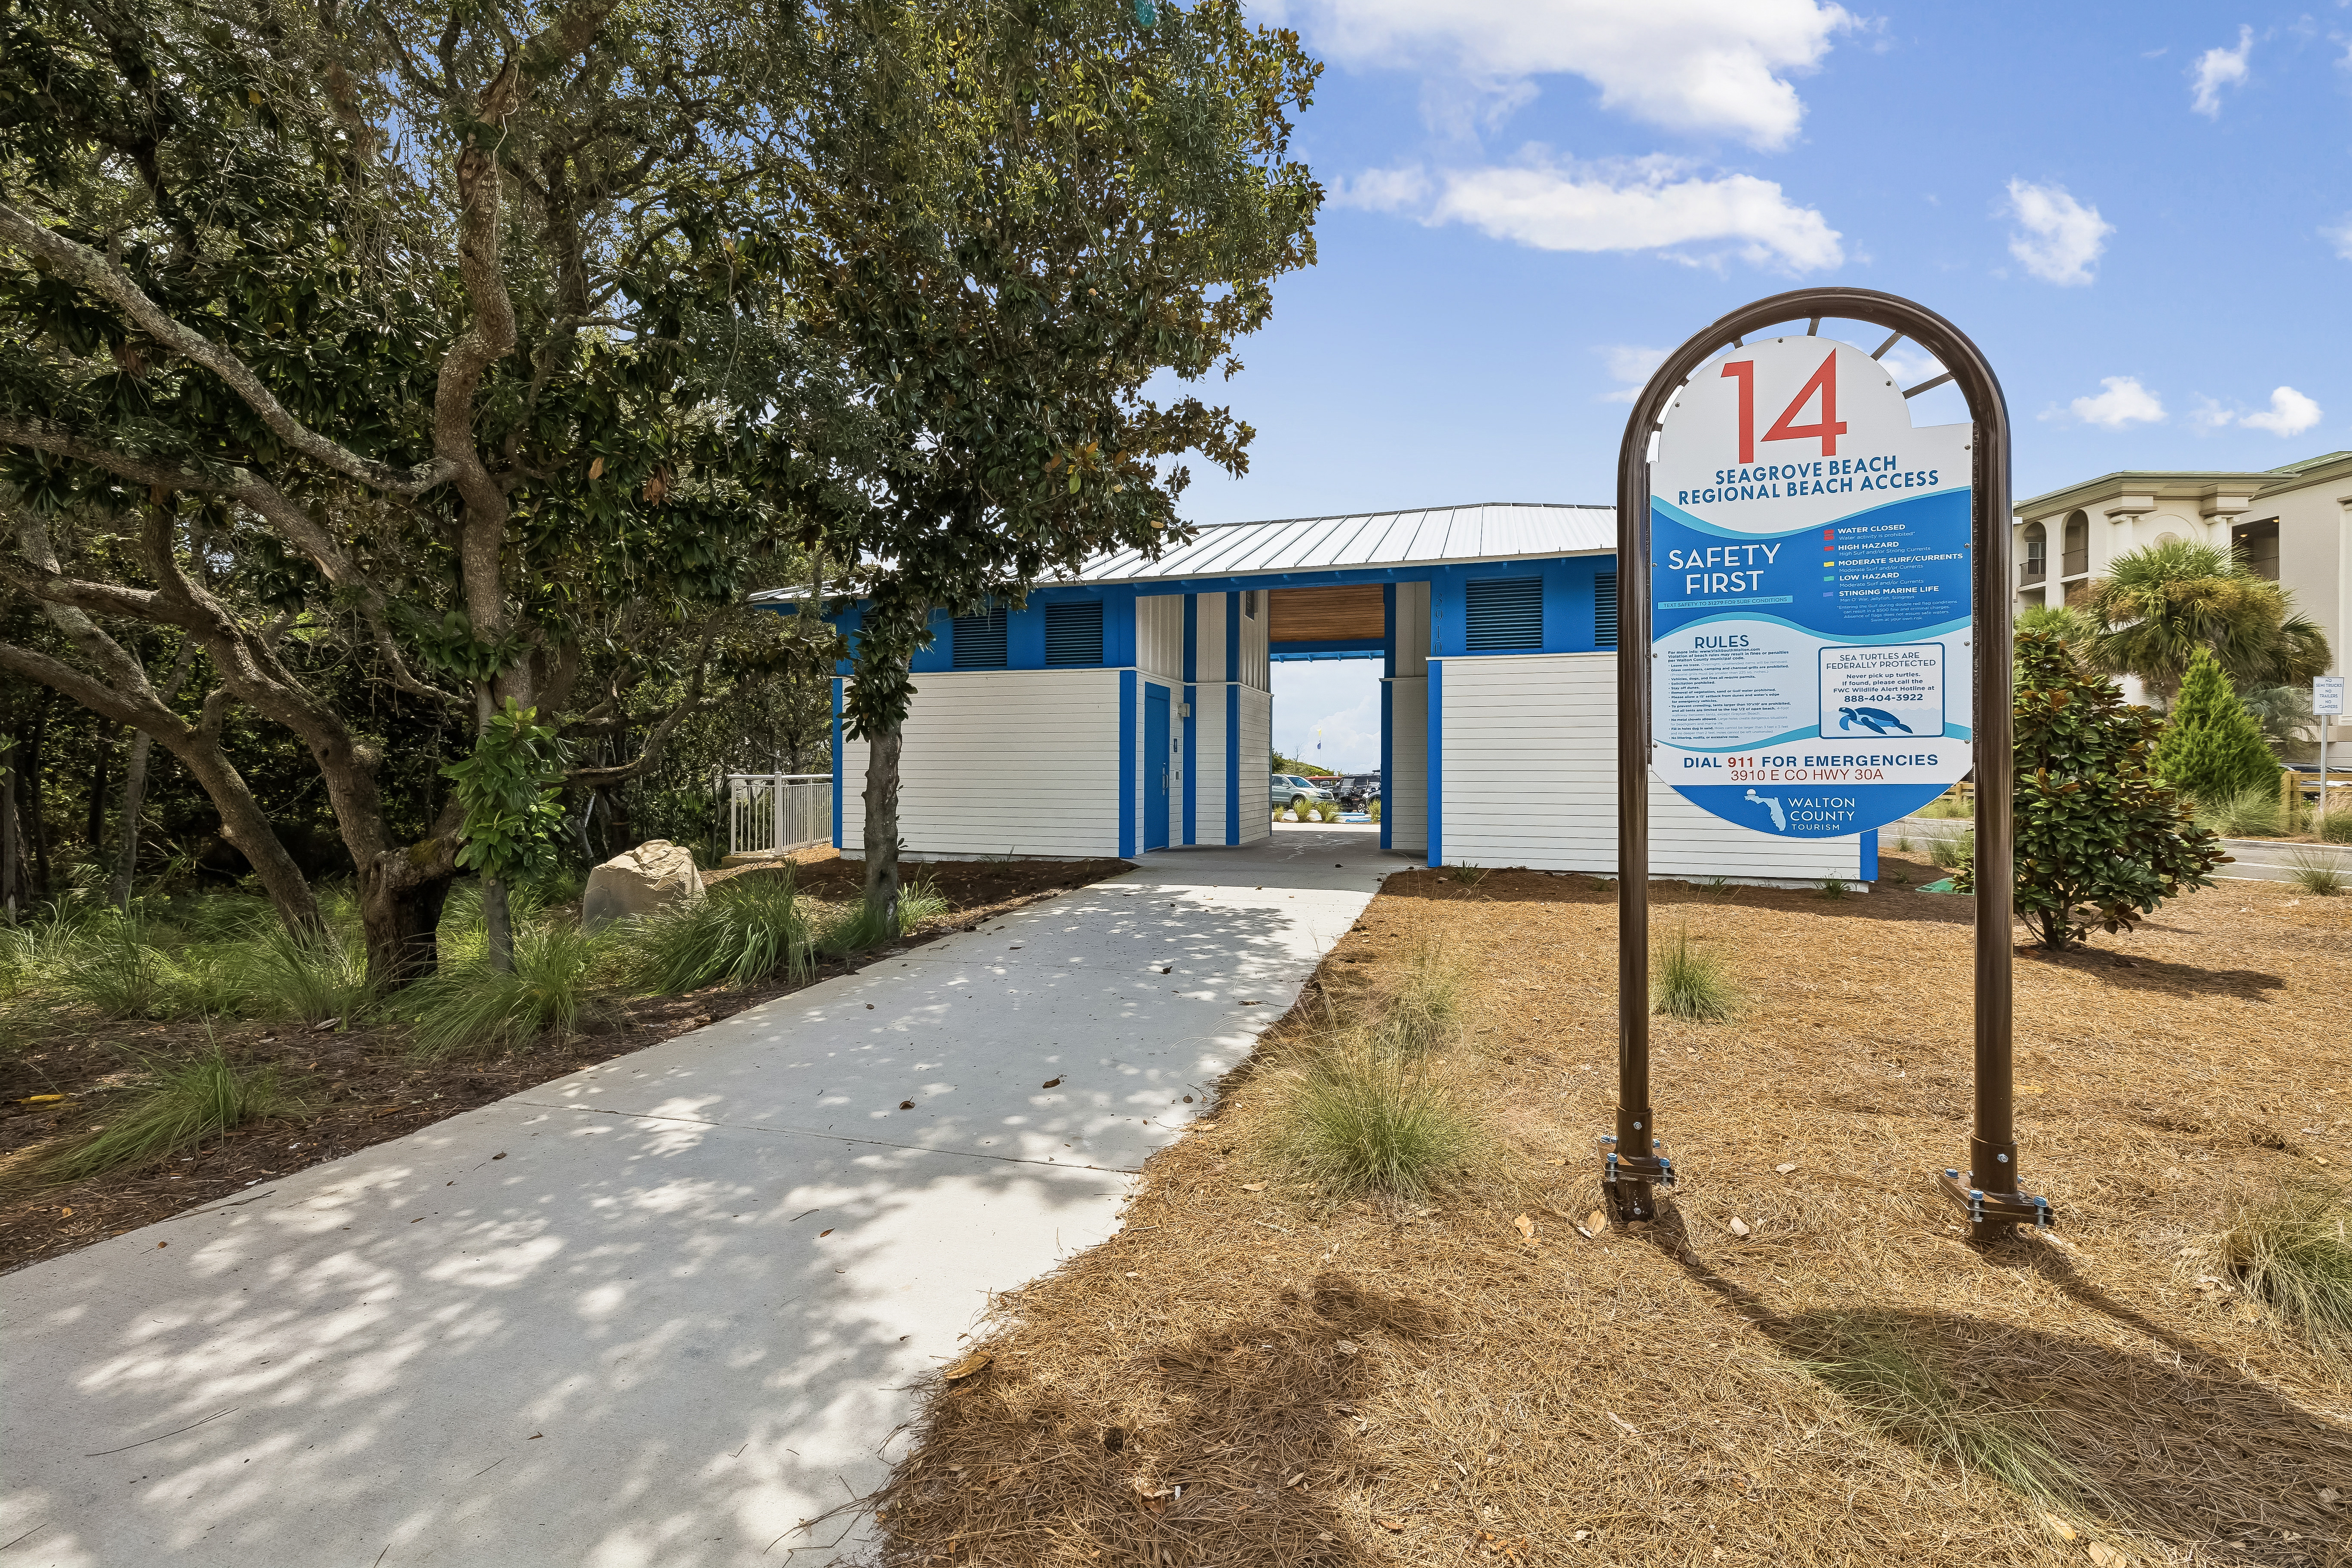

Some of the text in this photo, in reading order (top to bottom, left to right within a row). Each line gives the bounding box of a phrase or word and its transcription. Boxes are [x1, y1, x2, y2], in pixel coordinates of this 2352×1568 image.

[1721, 347, 1847, 464] 14
[1715, 455, 1896, 485] SEAGROVE BEACH
[1679, 470, 1939, 505] REGIONAL BEACH ACCESS
[1862, 541, 1899, 549] HAZARD
[1668, 543, 1781, 570] SAFETY
[1838, 553, 1963, 566] MODERATE SURF/CURRENTS
[1686, 570, 1764, 594] FIRST
[1434, 593, 1444, 655] 3910
[1695, 634, 1749, 649] RULES
[1826, 659, 1936, 670] FEDERALLY PROTECTED
[1844, 693, 1923, 702] 888-404-3922
[1684, 754, 1938, 768] DIAL 911 FOR EMERGENCIES
[1731, 769, 1883, 781] 3910 E CO HWY 30A
[1788, 797, 1855, 808] WALTON
[1790, 811, 1854, 821] COUNTY
